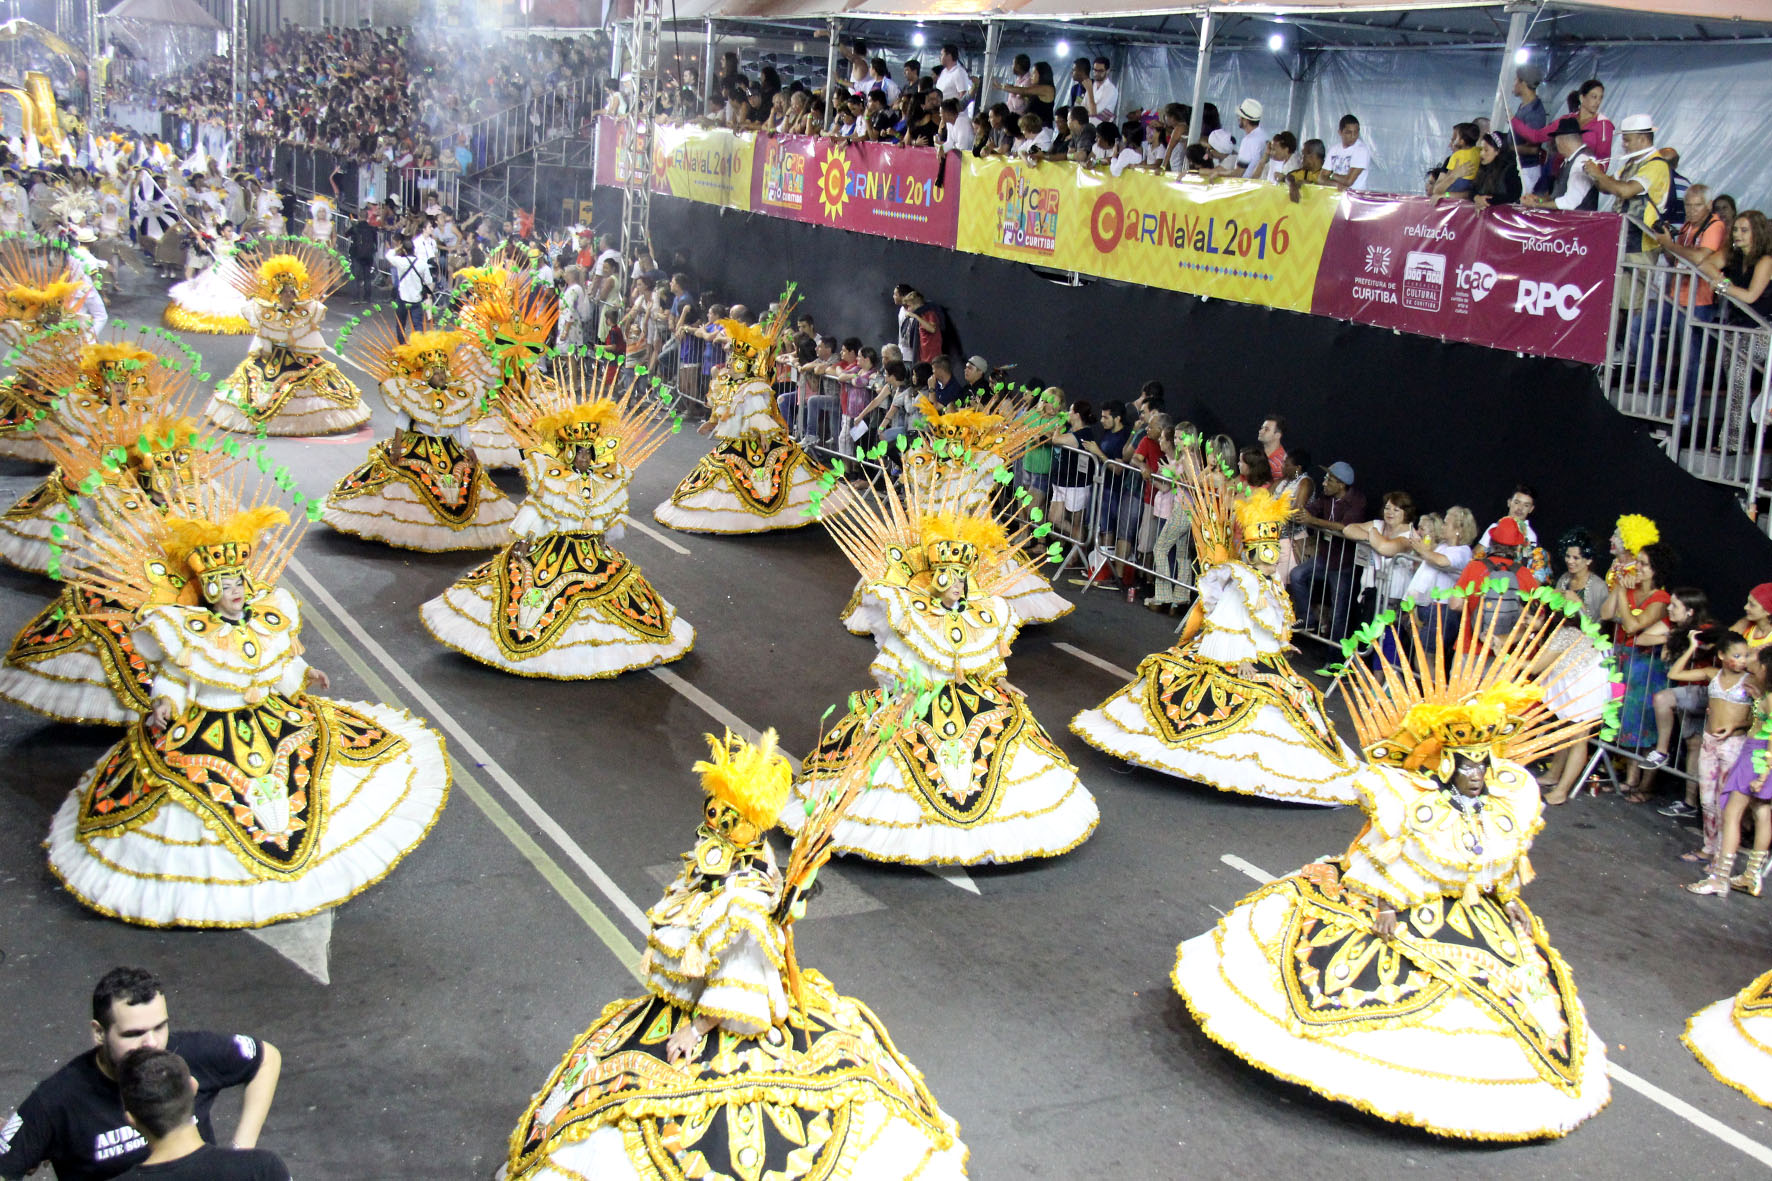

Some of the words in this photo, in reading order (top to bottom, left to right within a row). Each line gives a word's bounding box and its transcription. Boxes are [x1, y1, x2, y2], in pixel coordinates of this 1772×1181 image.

[714, 150, 742, 178] 2016
[1025, 235, 1055, 250] CURITIBA
[1222, 215, 1290, 260] 2016
[1354, 277, 1386, 289] PREFEITURA
[1352, 286, 1398, 304] CURITIBA
[1406, 288, 1437, 301] CULTURAL
[1514, 279, 1584, 321] RPC
[97, 1143, 125, 1160] LIVE
